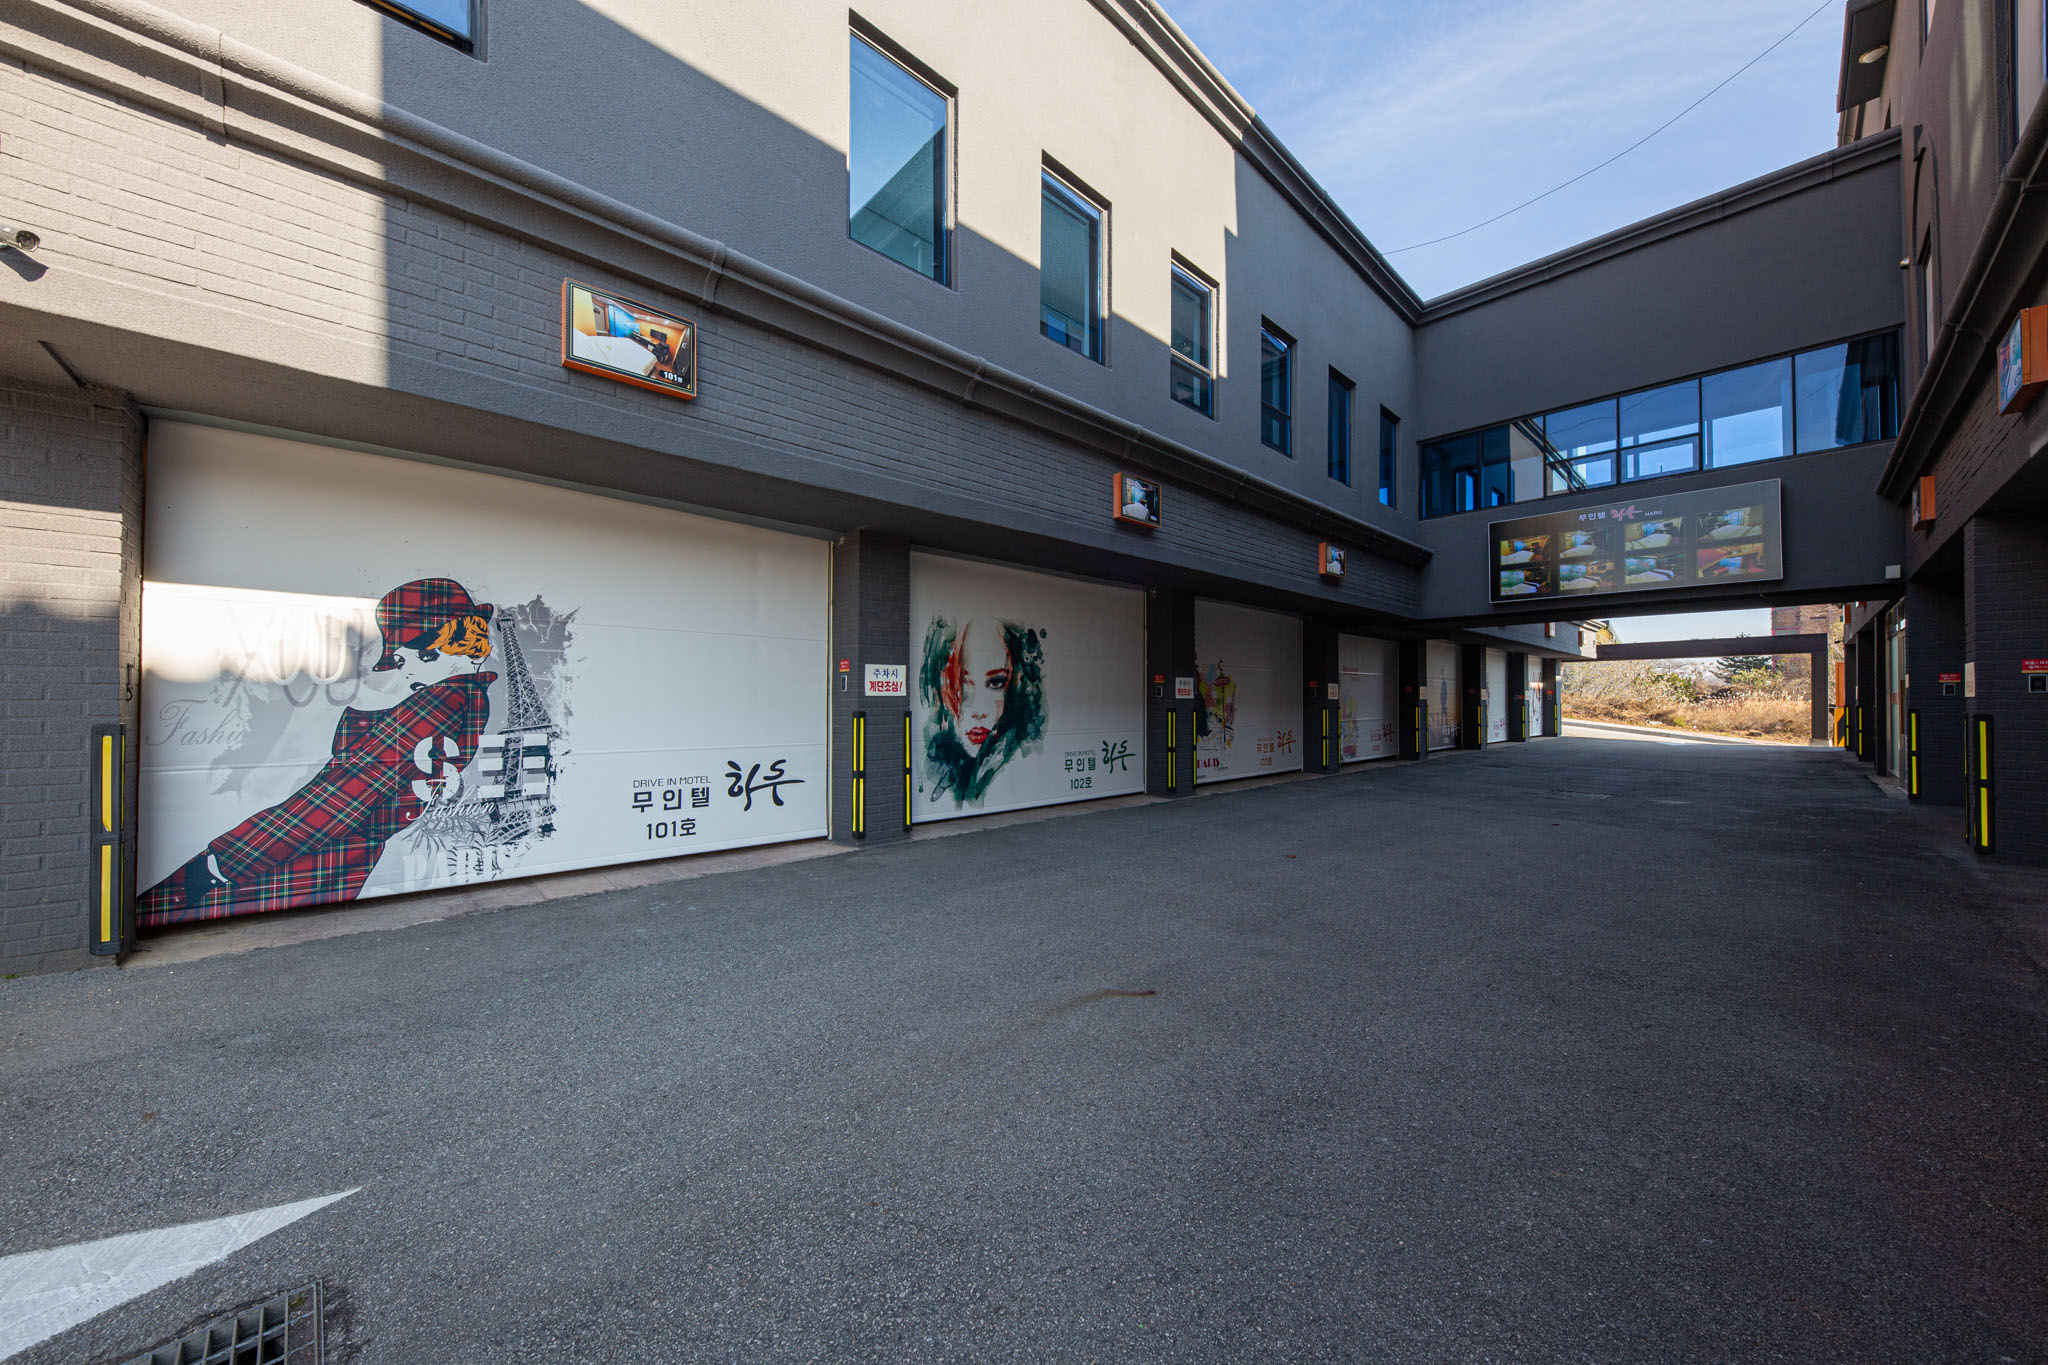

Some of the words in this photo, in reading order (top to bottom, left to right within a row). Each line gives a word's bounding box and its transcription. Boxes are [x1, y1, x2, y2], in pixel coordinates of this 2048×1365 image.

[1578, 511, 1606, 521] 무인텔
[873, 668, 899, 679] 주차시
[869, 680, 903, 692] 계단조심!
[1064, 757, 1096, 773] 무인텔
[632, 778, 664, 789] DRIVE
[666, 778, 677, 787] IN
[679, 776, 712, 786] MOTEL
[1070, 776, 1092, 790] 102호
[406, 778, 496, 821] Fashion
[632, 787, 710, 813] 무인텔
[646, 818, 697, 840] 101호
